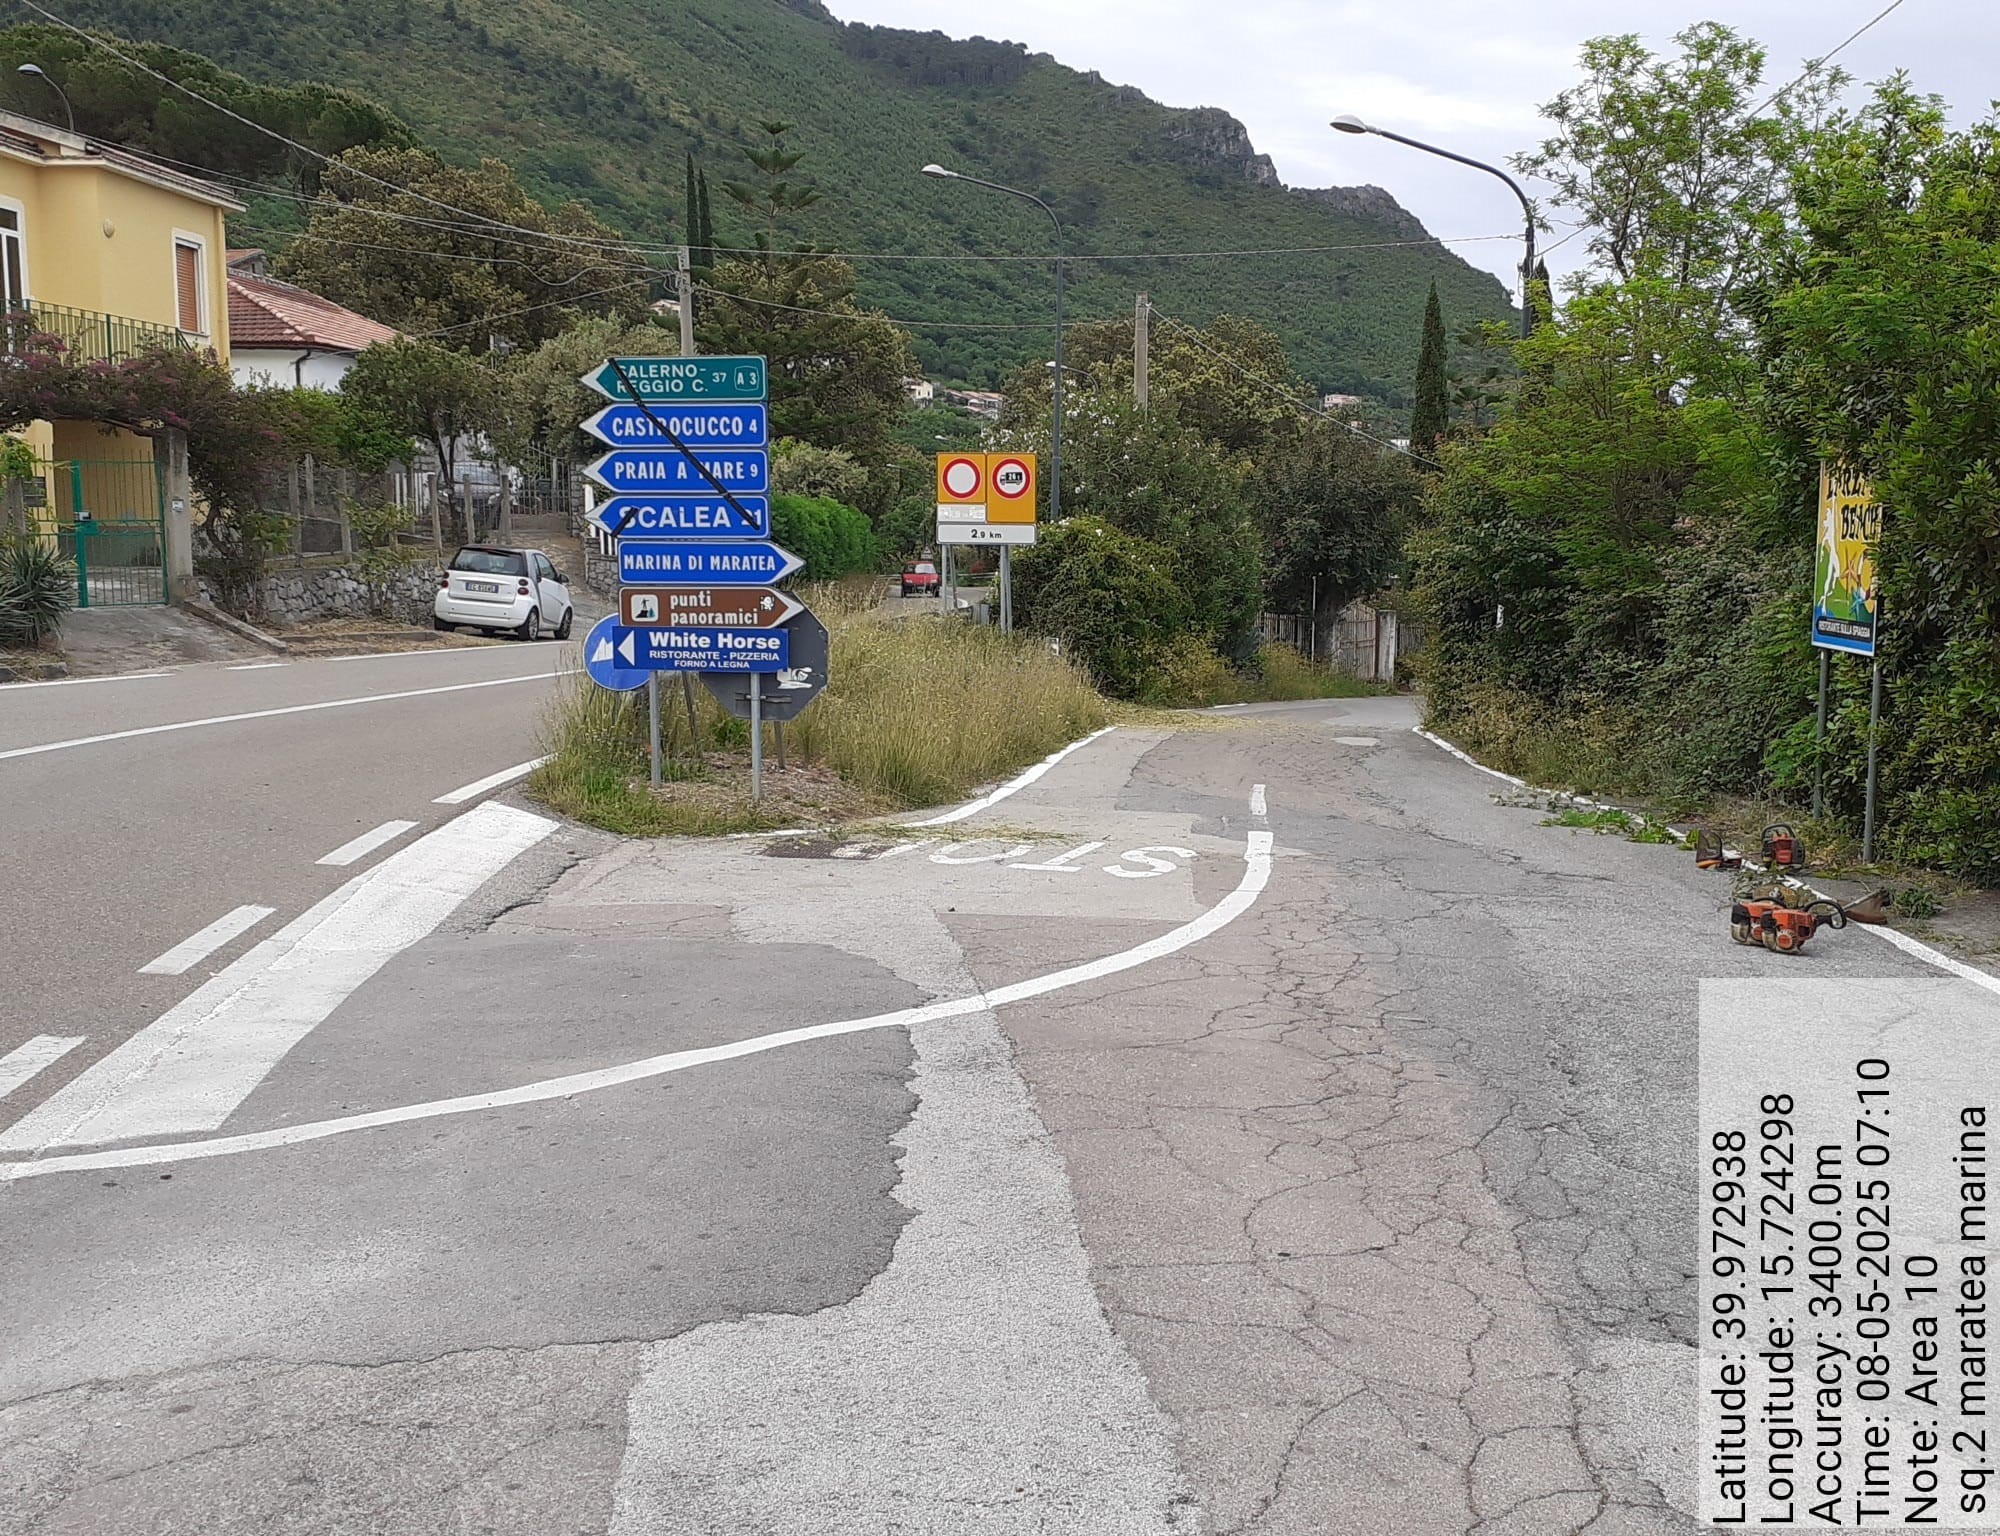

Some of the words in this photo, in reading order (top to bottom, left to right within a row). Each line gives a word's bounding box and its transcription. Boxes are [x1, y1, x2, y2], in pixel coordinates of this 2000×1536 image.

[617, 364, 706, 378] SALERNO-
[712, 372, 727, 383] 37
[737, 372, 744, 385] A
[750, 372, 757, 385] 3
[617, 379, 684, 393] REGGIO
[692, 379, 708, 392] C.
[612, 416, 743, 436] CASTROCUCCO
[749, 419, 757, 433] 4
[614, 461, 666, 479] PRAIA
[677, 461, 687, 479] A
[750, 463, 758, 477] 9
[619, 506, 731, 528] SCALEA
[741, 509, 761, 526] 21
[1841, 503, 1880, 541] BEACH
[990, 530, 1002, 539] km
[624, 554, 681, 571] MARINA
[688, 555, 703, 571] DI
[710, 555, 776, 571] MARATEA
[670, 590, 711, 608] punti
[670, 608, 758, 627] panoramici
[649, 631, 711, 648] White
[717, 632, 781, 650] Horse
[649, 650, 720, 660] RISTORANTE
[729, 651, 780, 661] PIZZERIA
[674, 658, 708, 668] FORNO
[709, 659, 716, 668] A
[717, 659, 750, 669] LEGNA
